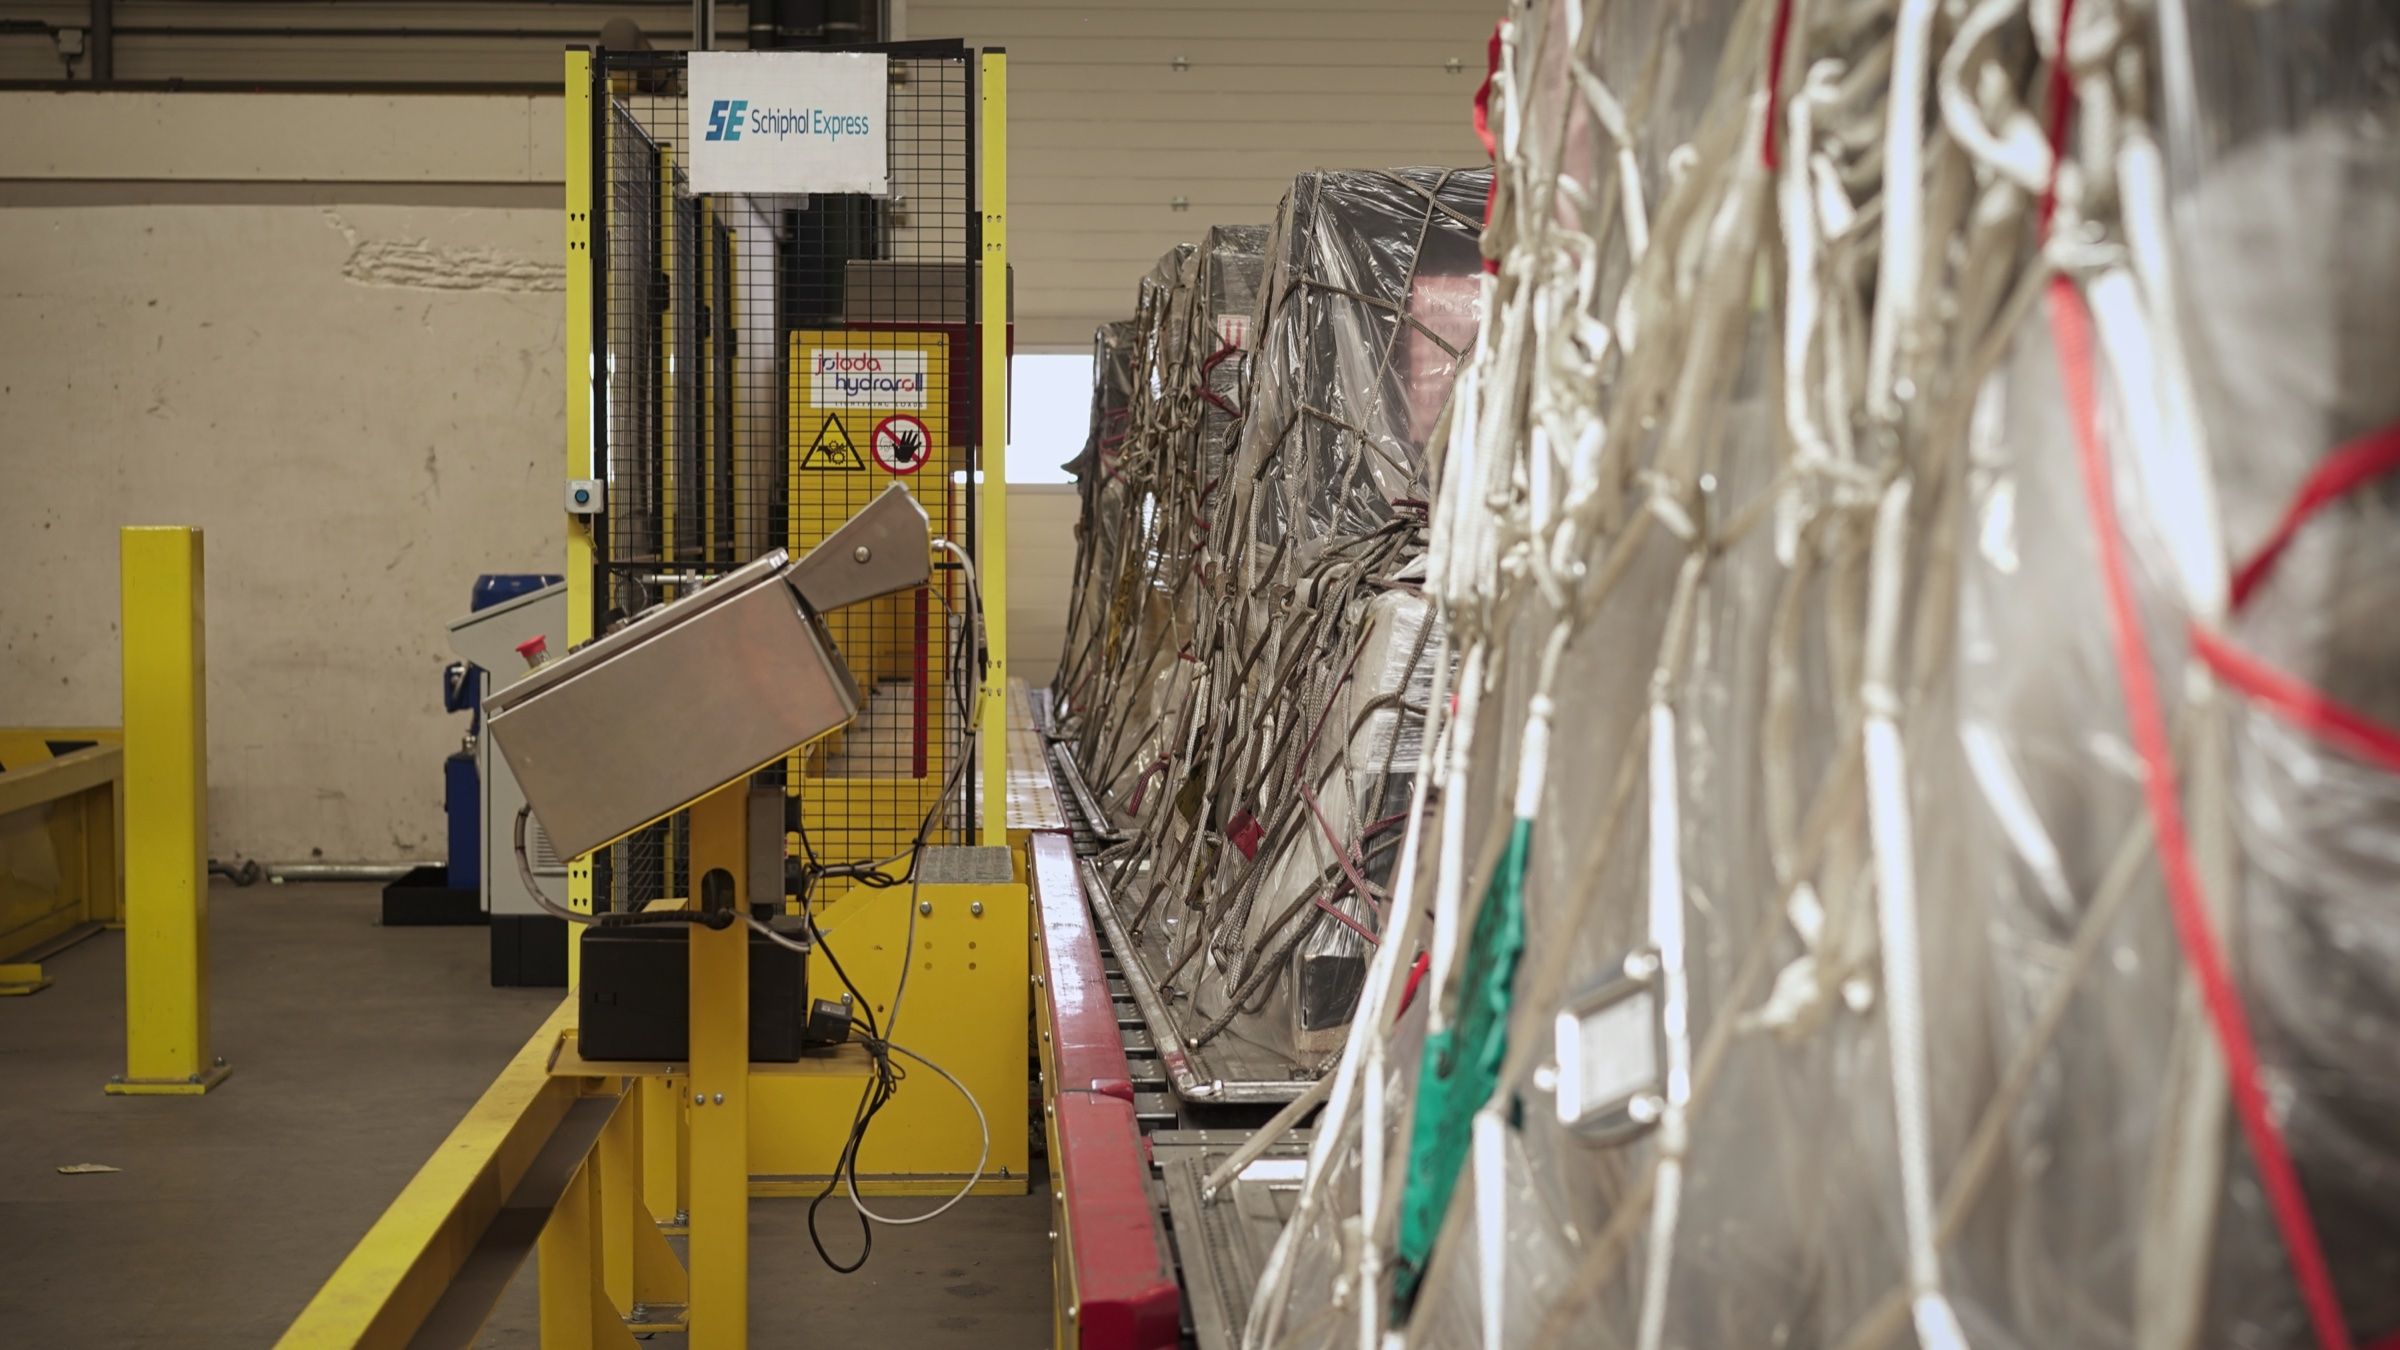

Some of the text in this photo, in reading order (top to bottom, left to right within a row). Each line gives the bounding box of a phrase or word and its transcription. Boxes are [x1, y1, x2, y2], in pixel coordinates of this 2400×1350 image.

[705, 100, 869, 142] SE Schiphol Express
[815, 352, 881, 375] joloda
[836, 372, 923, 396] hydraroll
